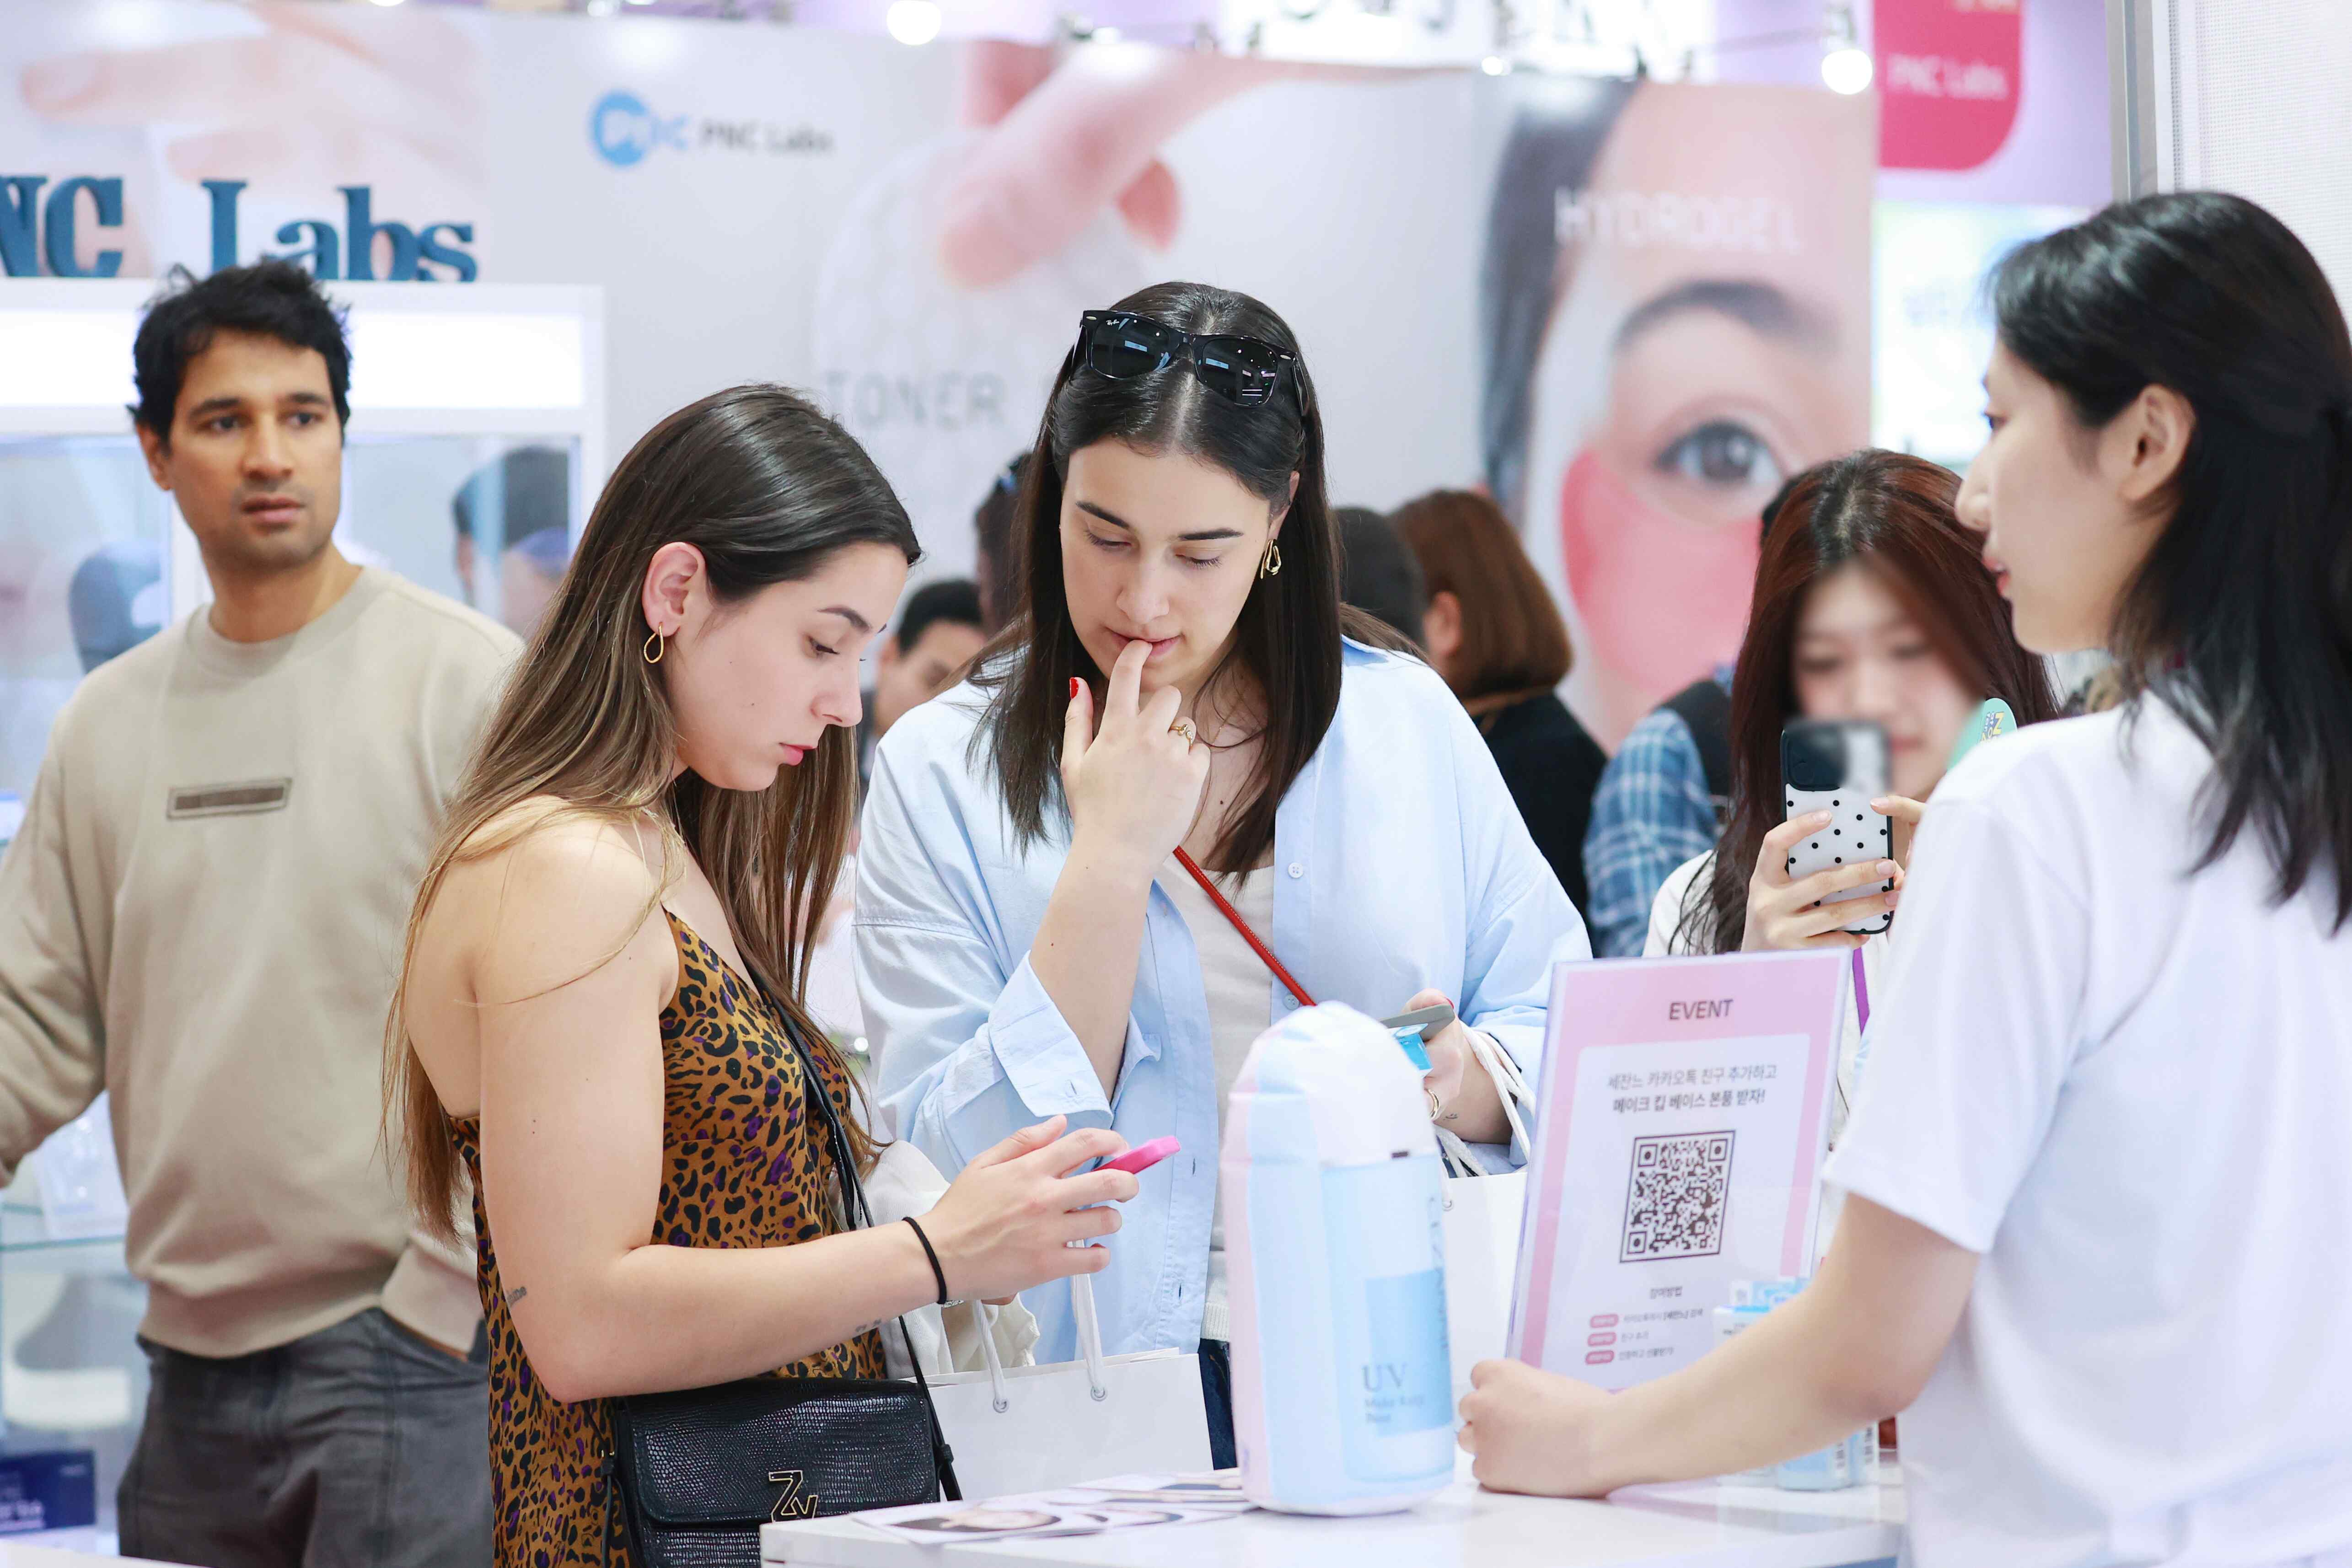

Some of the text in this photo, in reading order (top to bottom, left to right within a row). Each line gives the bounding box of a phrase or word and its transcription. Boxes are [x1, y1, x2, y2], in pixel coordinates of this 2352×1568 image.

[1669, 998, 1734, 1020] EVENT
[1647, 1069, 1697, 1087] 카카오톡
[1361, 1362, 1408, 1392] UV
